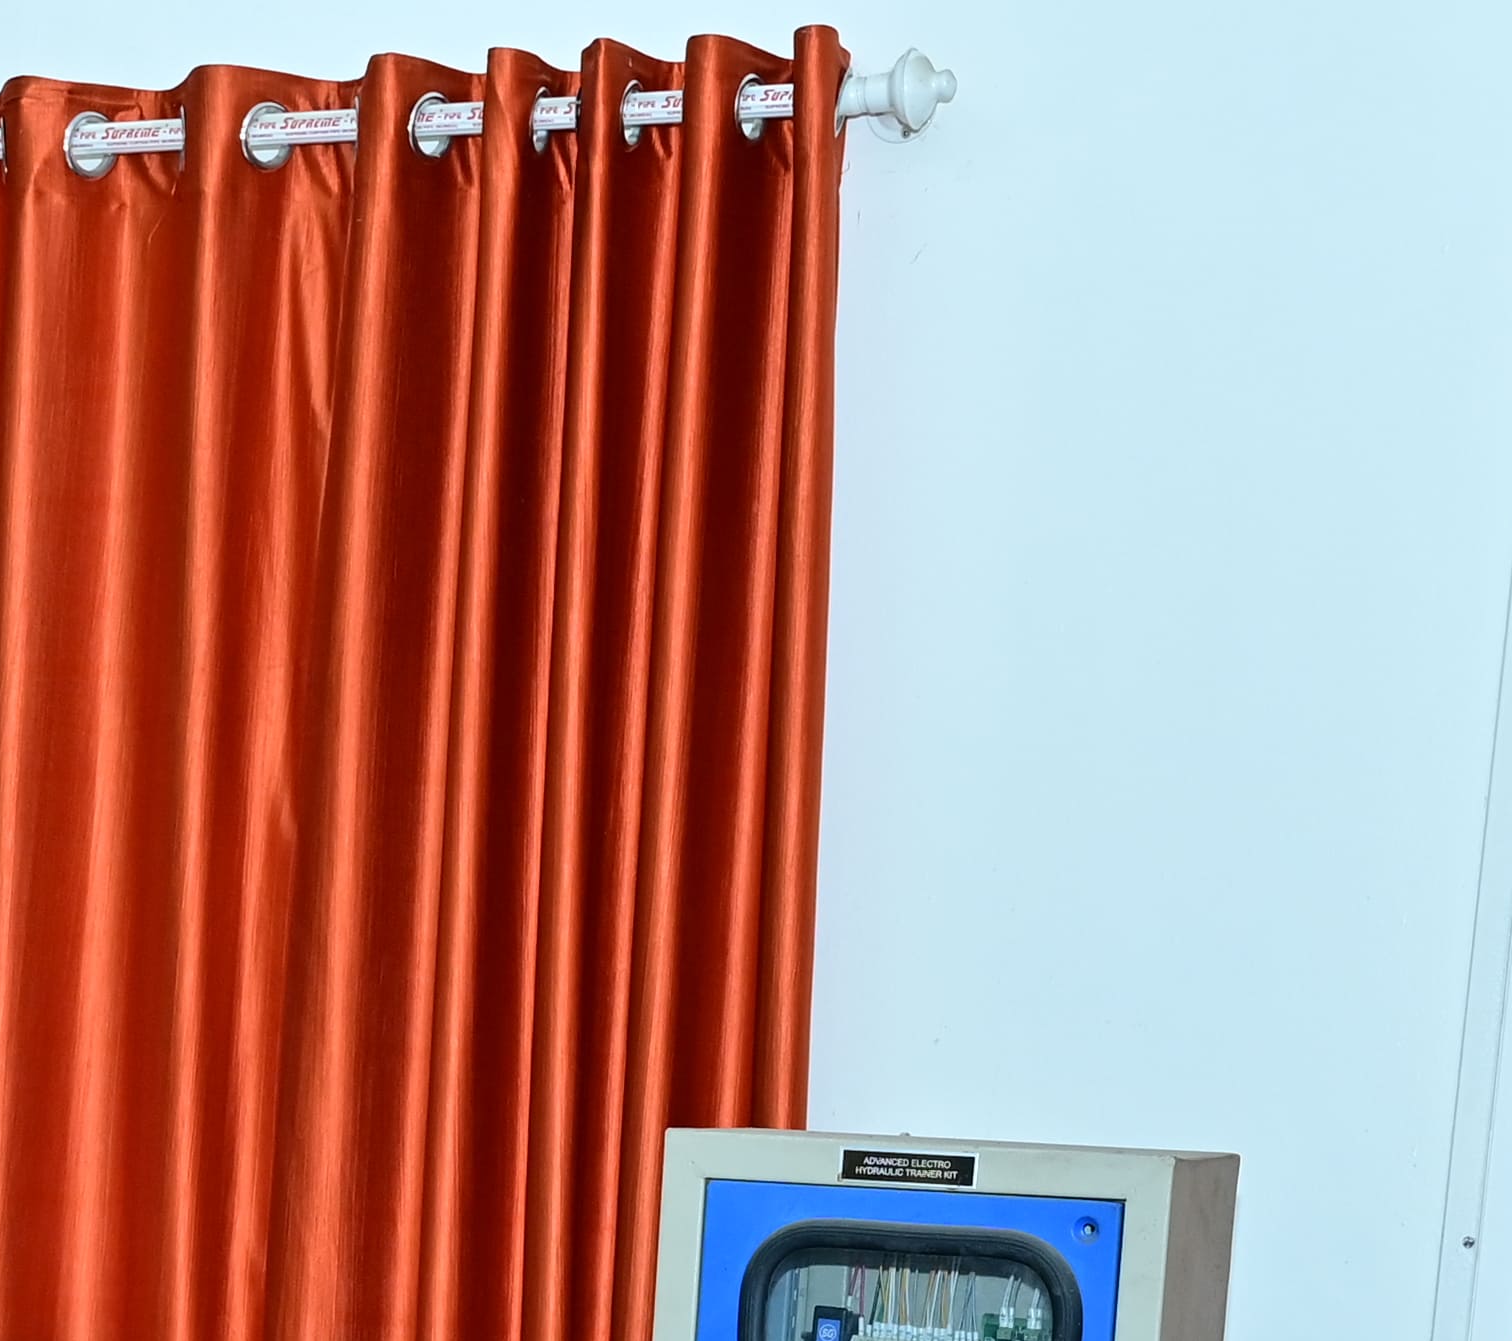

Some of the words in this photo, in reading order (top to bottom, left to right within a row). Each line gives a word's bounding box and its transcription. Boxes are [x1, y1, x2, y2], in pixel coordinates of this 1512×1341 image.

[863, 1156, 910, 1166] ADVANCED
[911, 1159, 952, 1168] ELECTRO
[855, 1166, 904, 1176] HYDRAULIC
[906, 1169, 942, 1178] TRAINER
[943, 1170, 958, 1180] KIT
